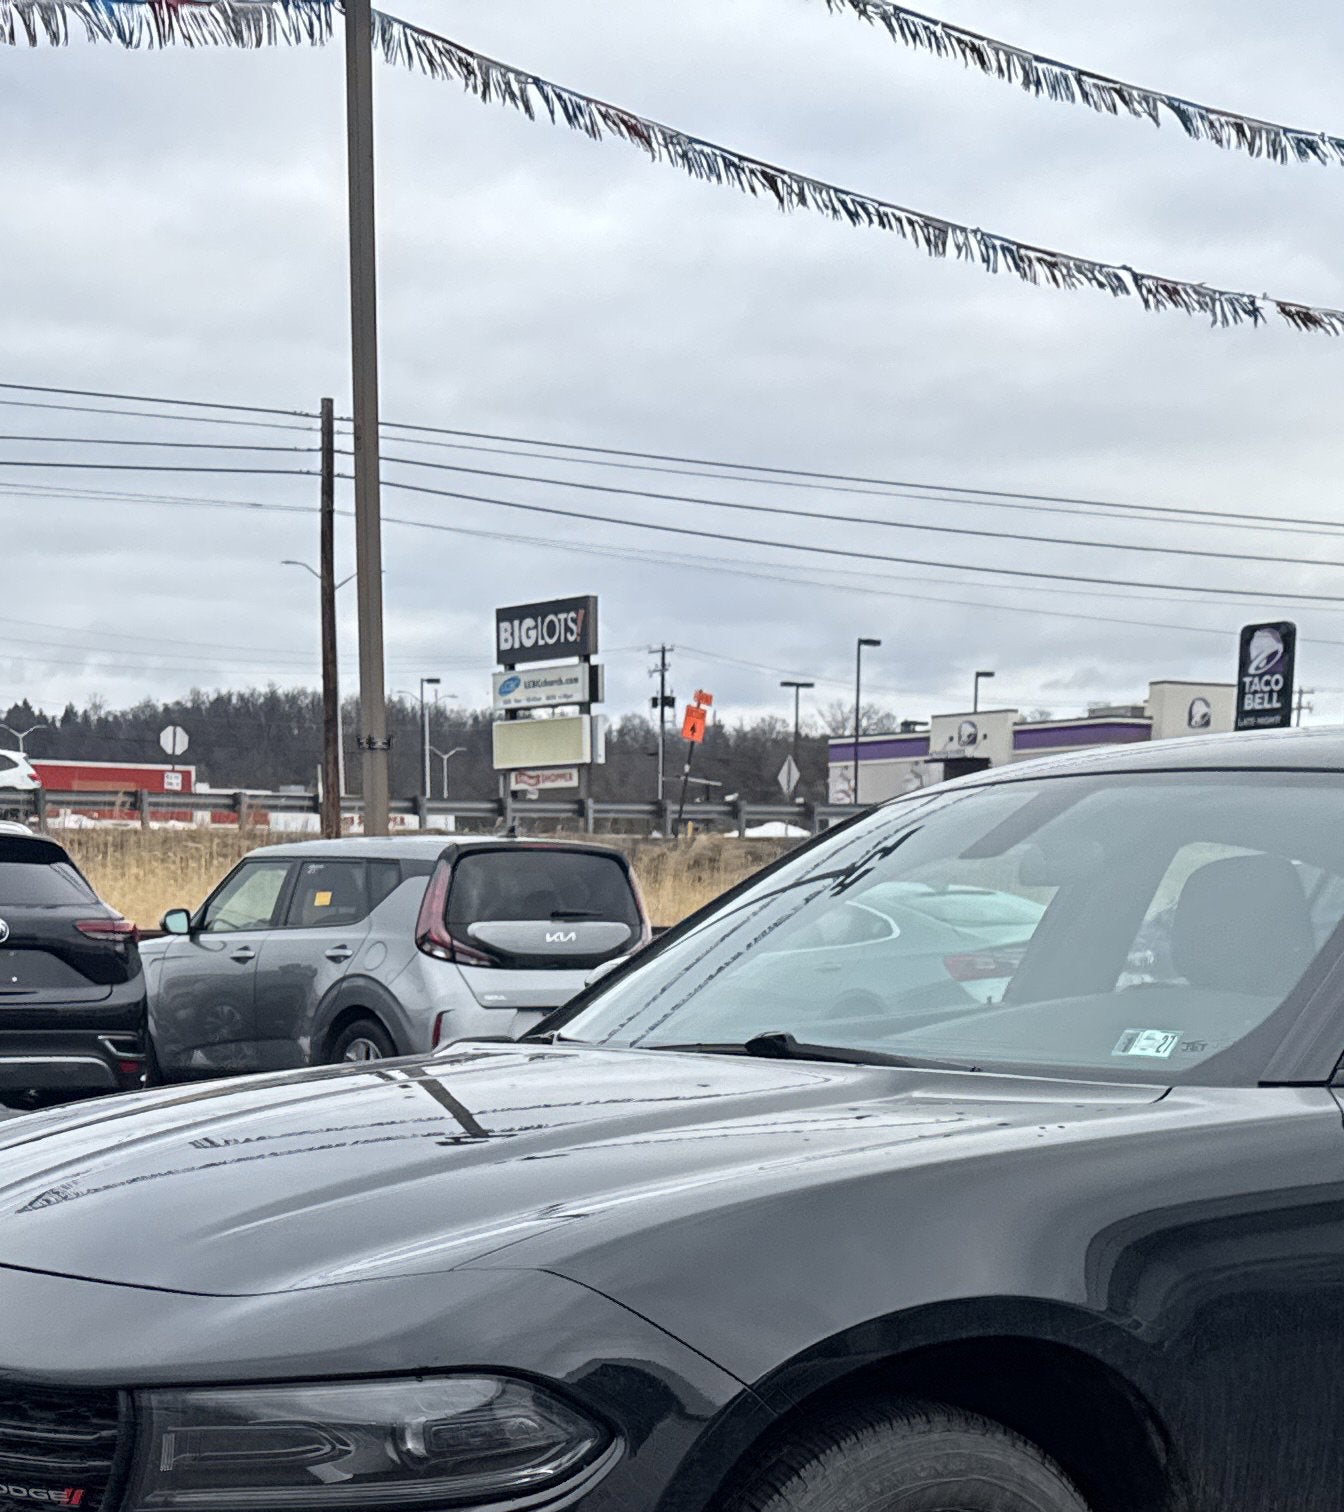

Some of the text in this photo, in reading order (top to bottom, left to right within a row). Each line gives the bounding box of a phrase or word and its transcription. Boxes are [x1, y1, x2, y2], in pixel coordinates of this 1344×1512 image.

[1242, 674, 1284, 693] TACO
[1243, 692, 1282, 710] BELL
[1155, 1034, 1177, 1053] 27
